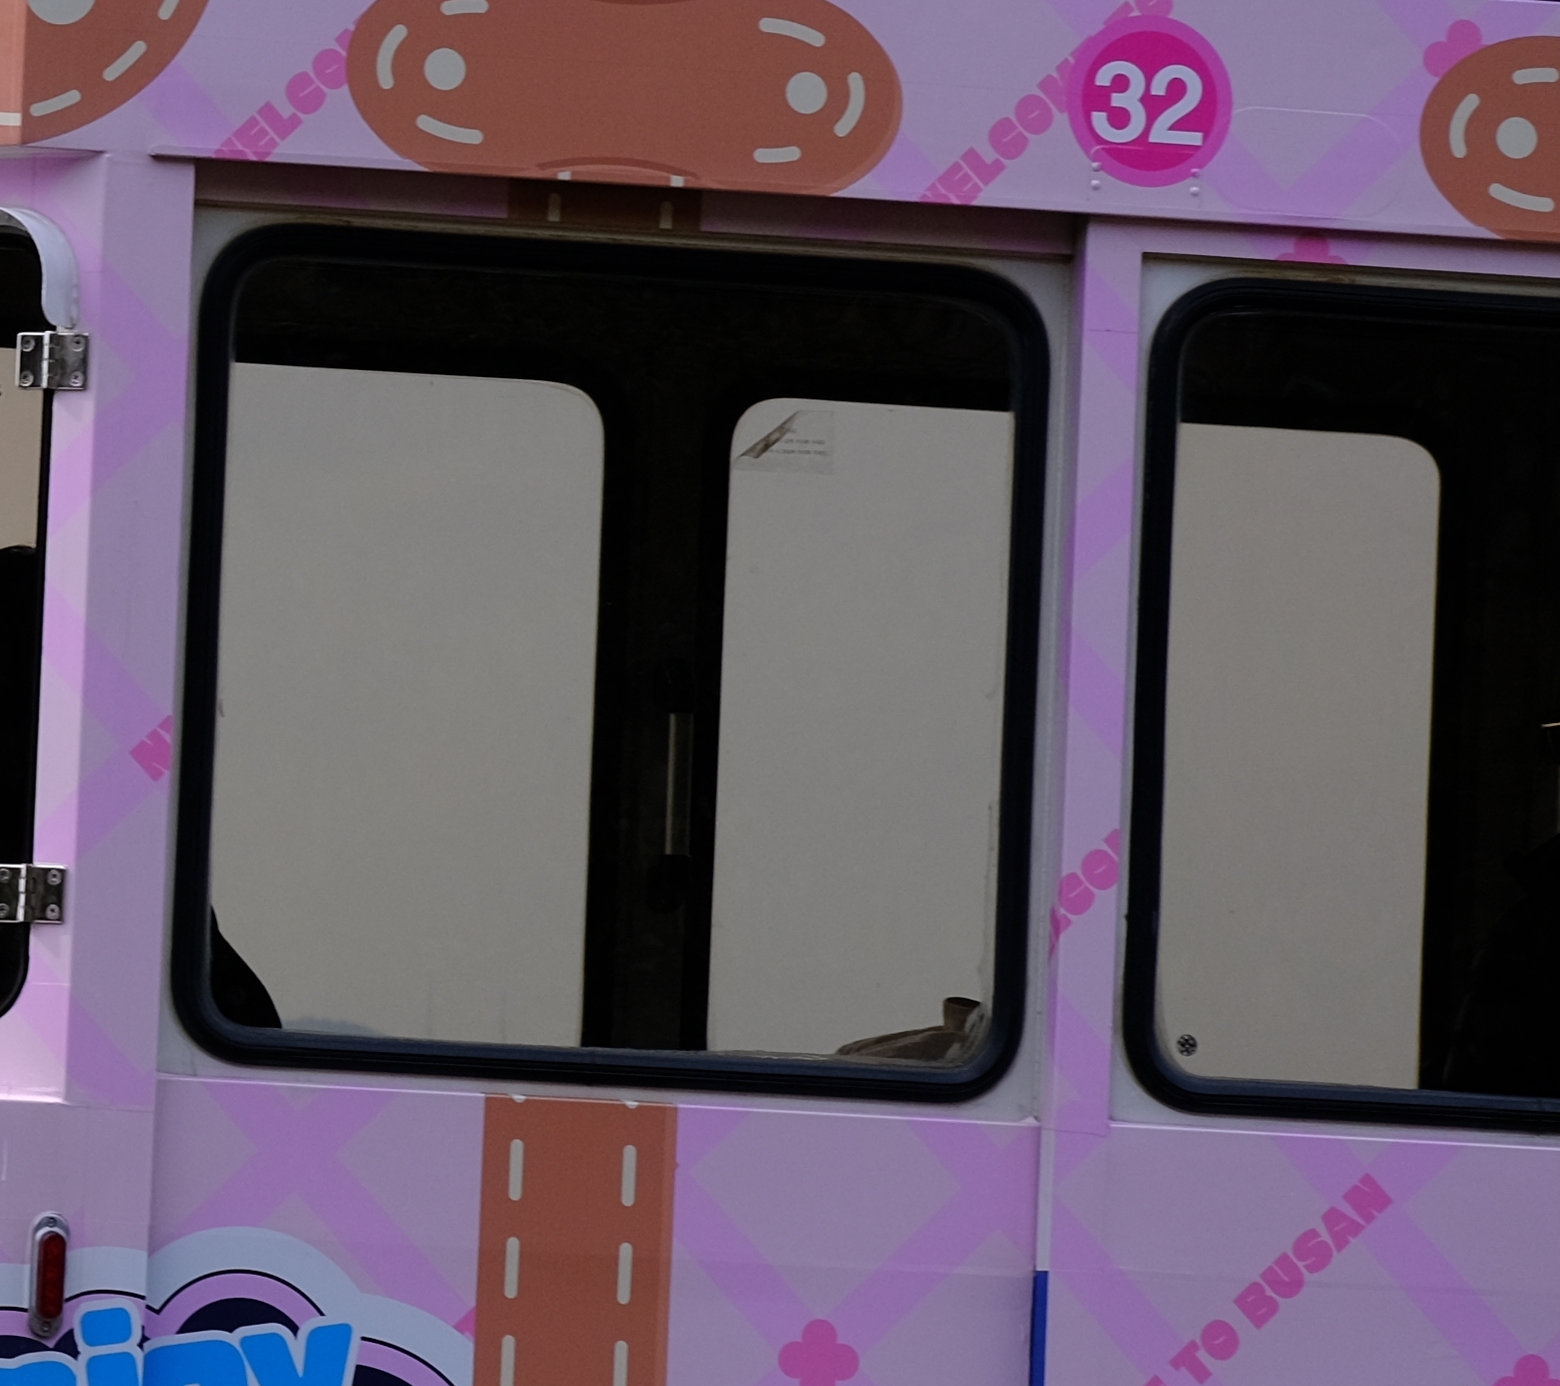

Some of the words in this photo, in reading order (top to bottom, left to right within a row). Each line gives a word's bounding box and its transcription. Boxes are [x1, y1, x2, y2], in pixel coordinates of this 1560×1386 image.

[1091, 60, 1204, 147] 32
[1168, 1319, 1241, 1385] TO
[1232, 1172, 1395, 1331] BUSAN
